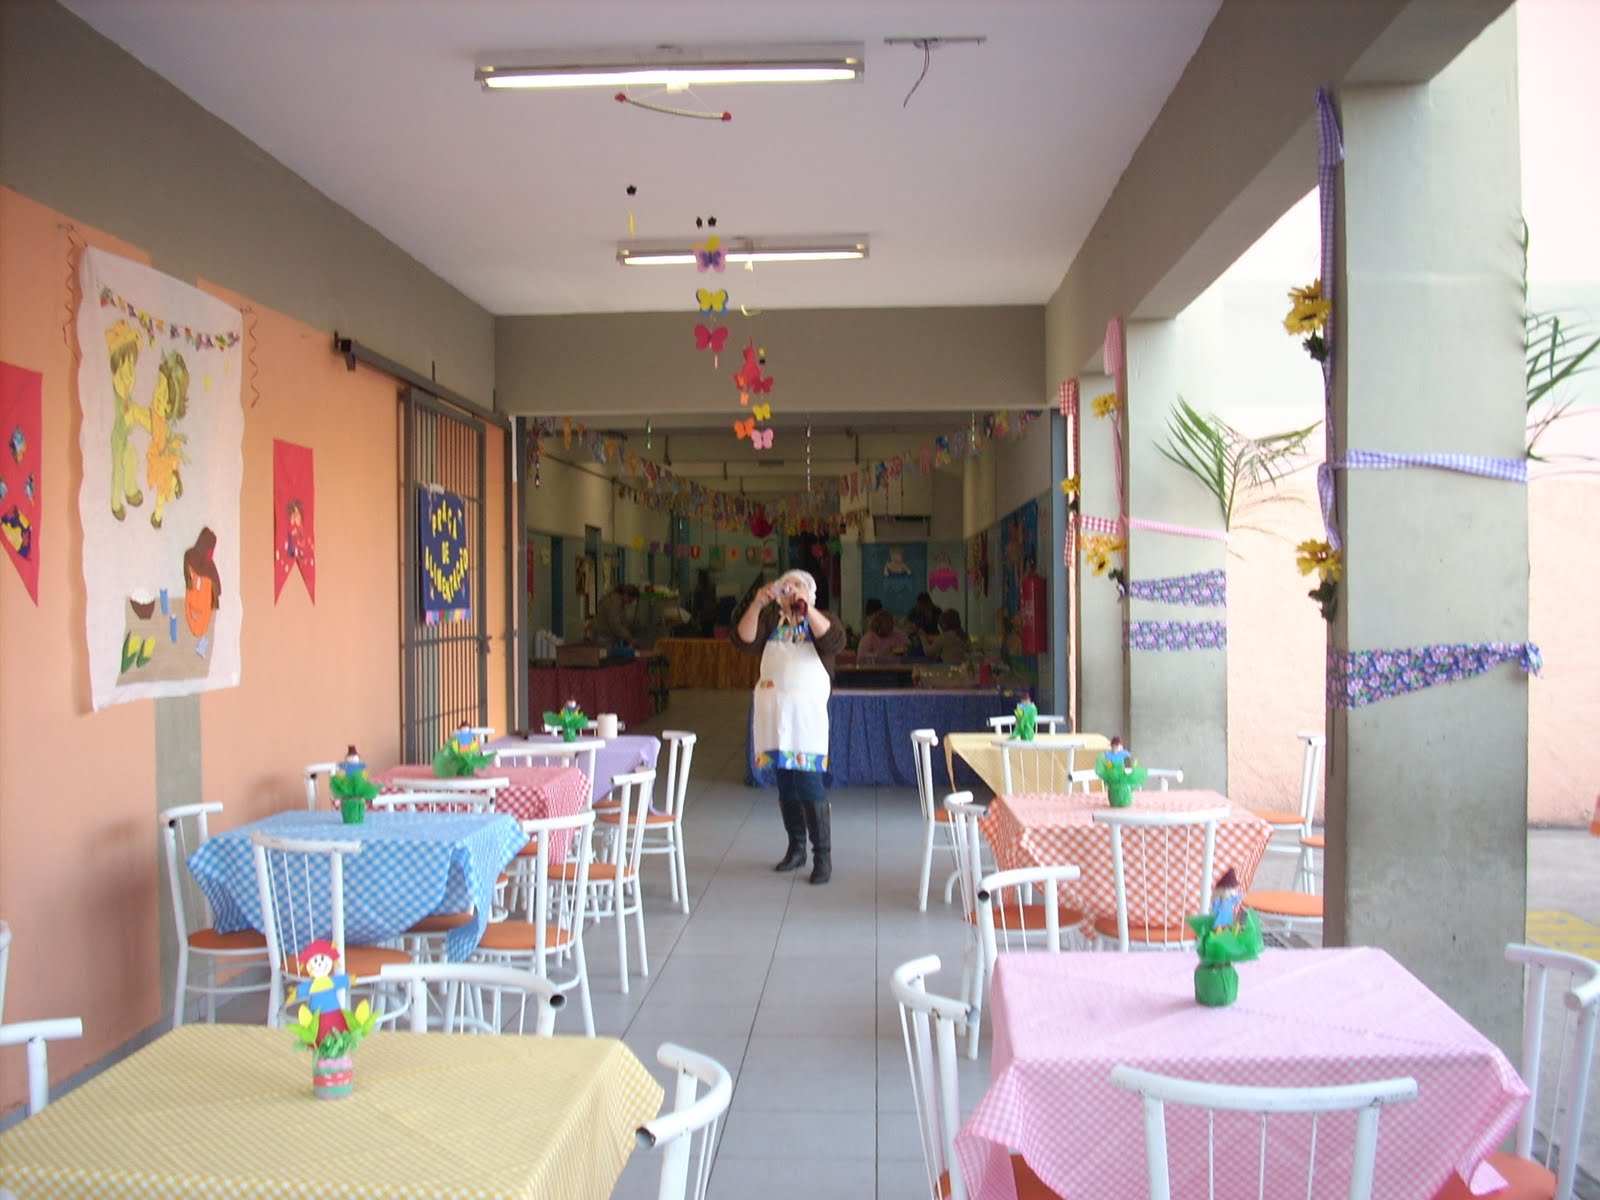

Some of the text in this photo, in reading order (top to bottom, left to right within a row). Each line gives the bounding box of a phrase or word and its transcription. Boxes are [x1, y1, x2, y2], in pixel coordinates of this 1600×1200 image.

[432, 500, 457, 540] PRAÇA
[441, 541, 450, 565] DE
[425, 545, 469, 603] ALIMENTAÇÃO
